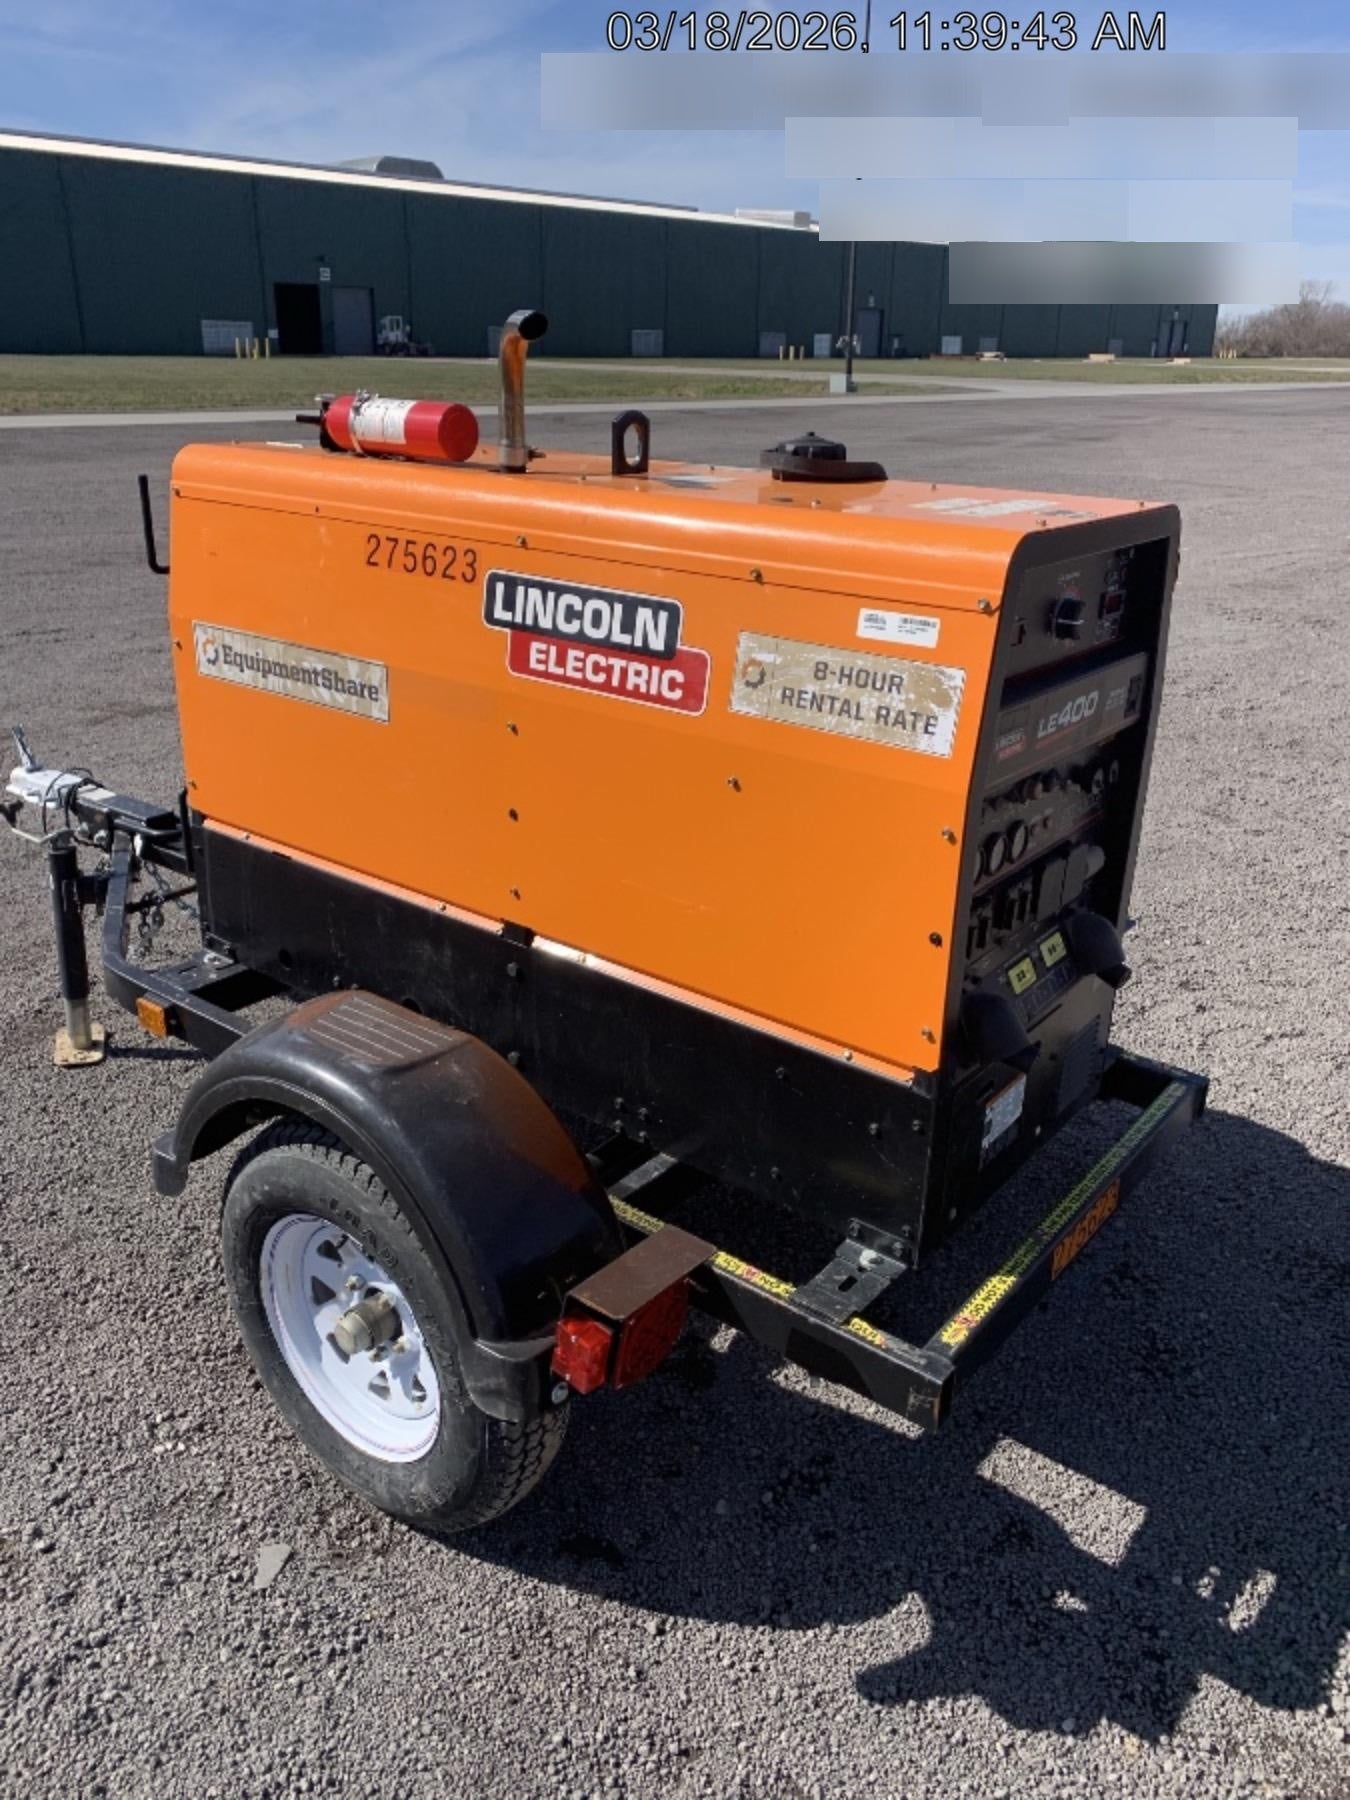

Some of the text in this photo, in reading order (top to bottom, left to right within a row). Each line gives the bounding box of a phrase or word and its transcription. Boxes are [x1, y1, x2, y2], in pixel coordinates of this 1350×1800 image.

[366, 534, 478, 583] 275623
[493, 582, 669, 650] LINCOLN
[222, 645, 379, 701] EquipmentShare
[529, 641, 685, 700] ELECTRIC
[814, 661, 904, 694] 8-HOUR
[781, 686, 939, 736] RENTAL RATE
